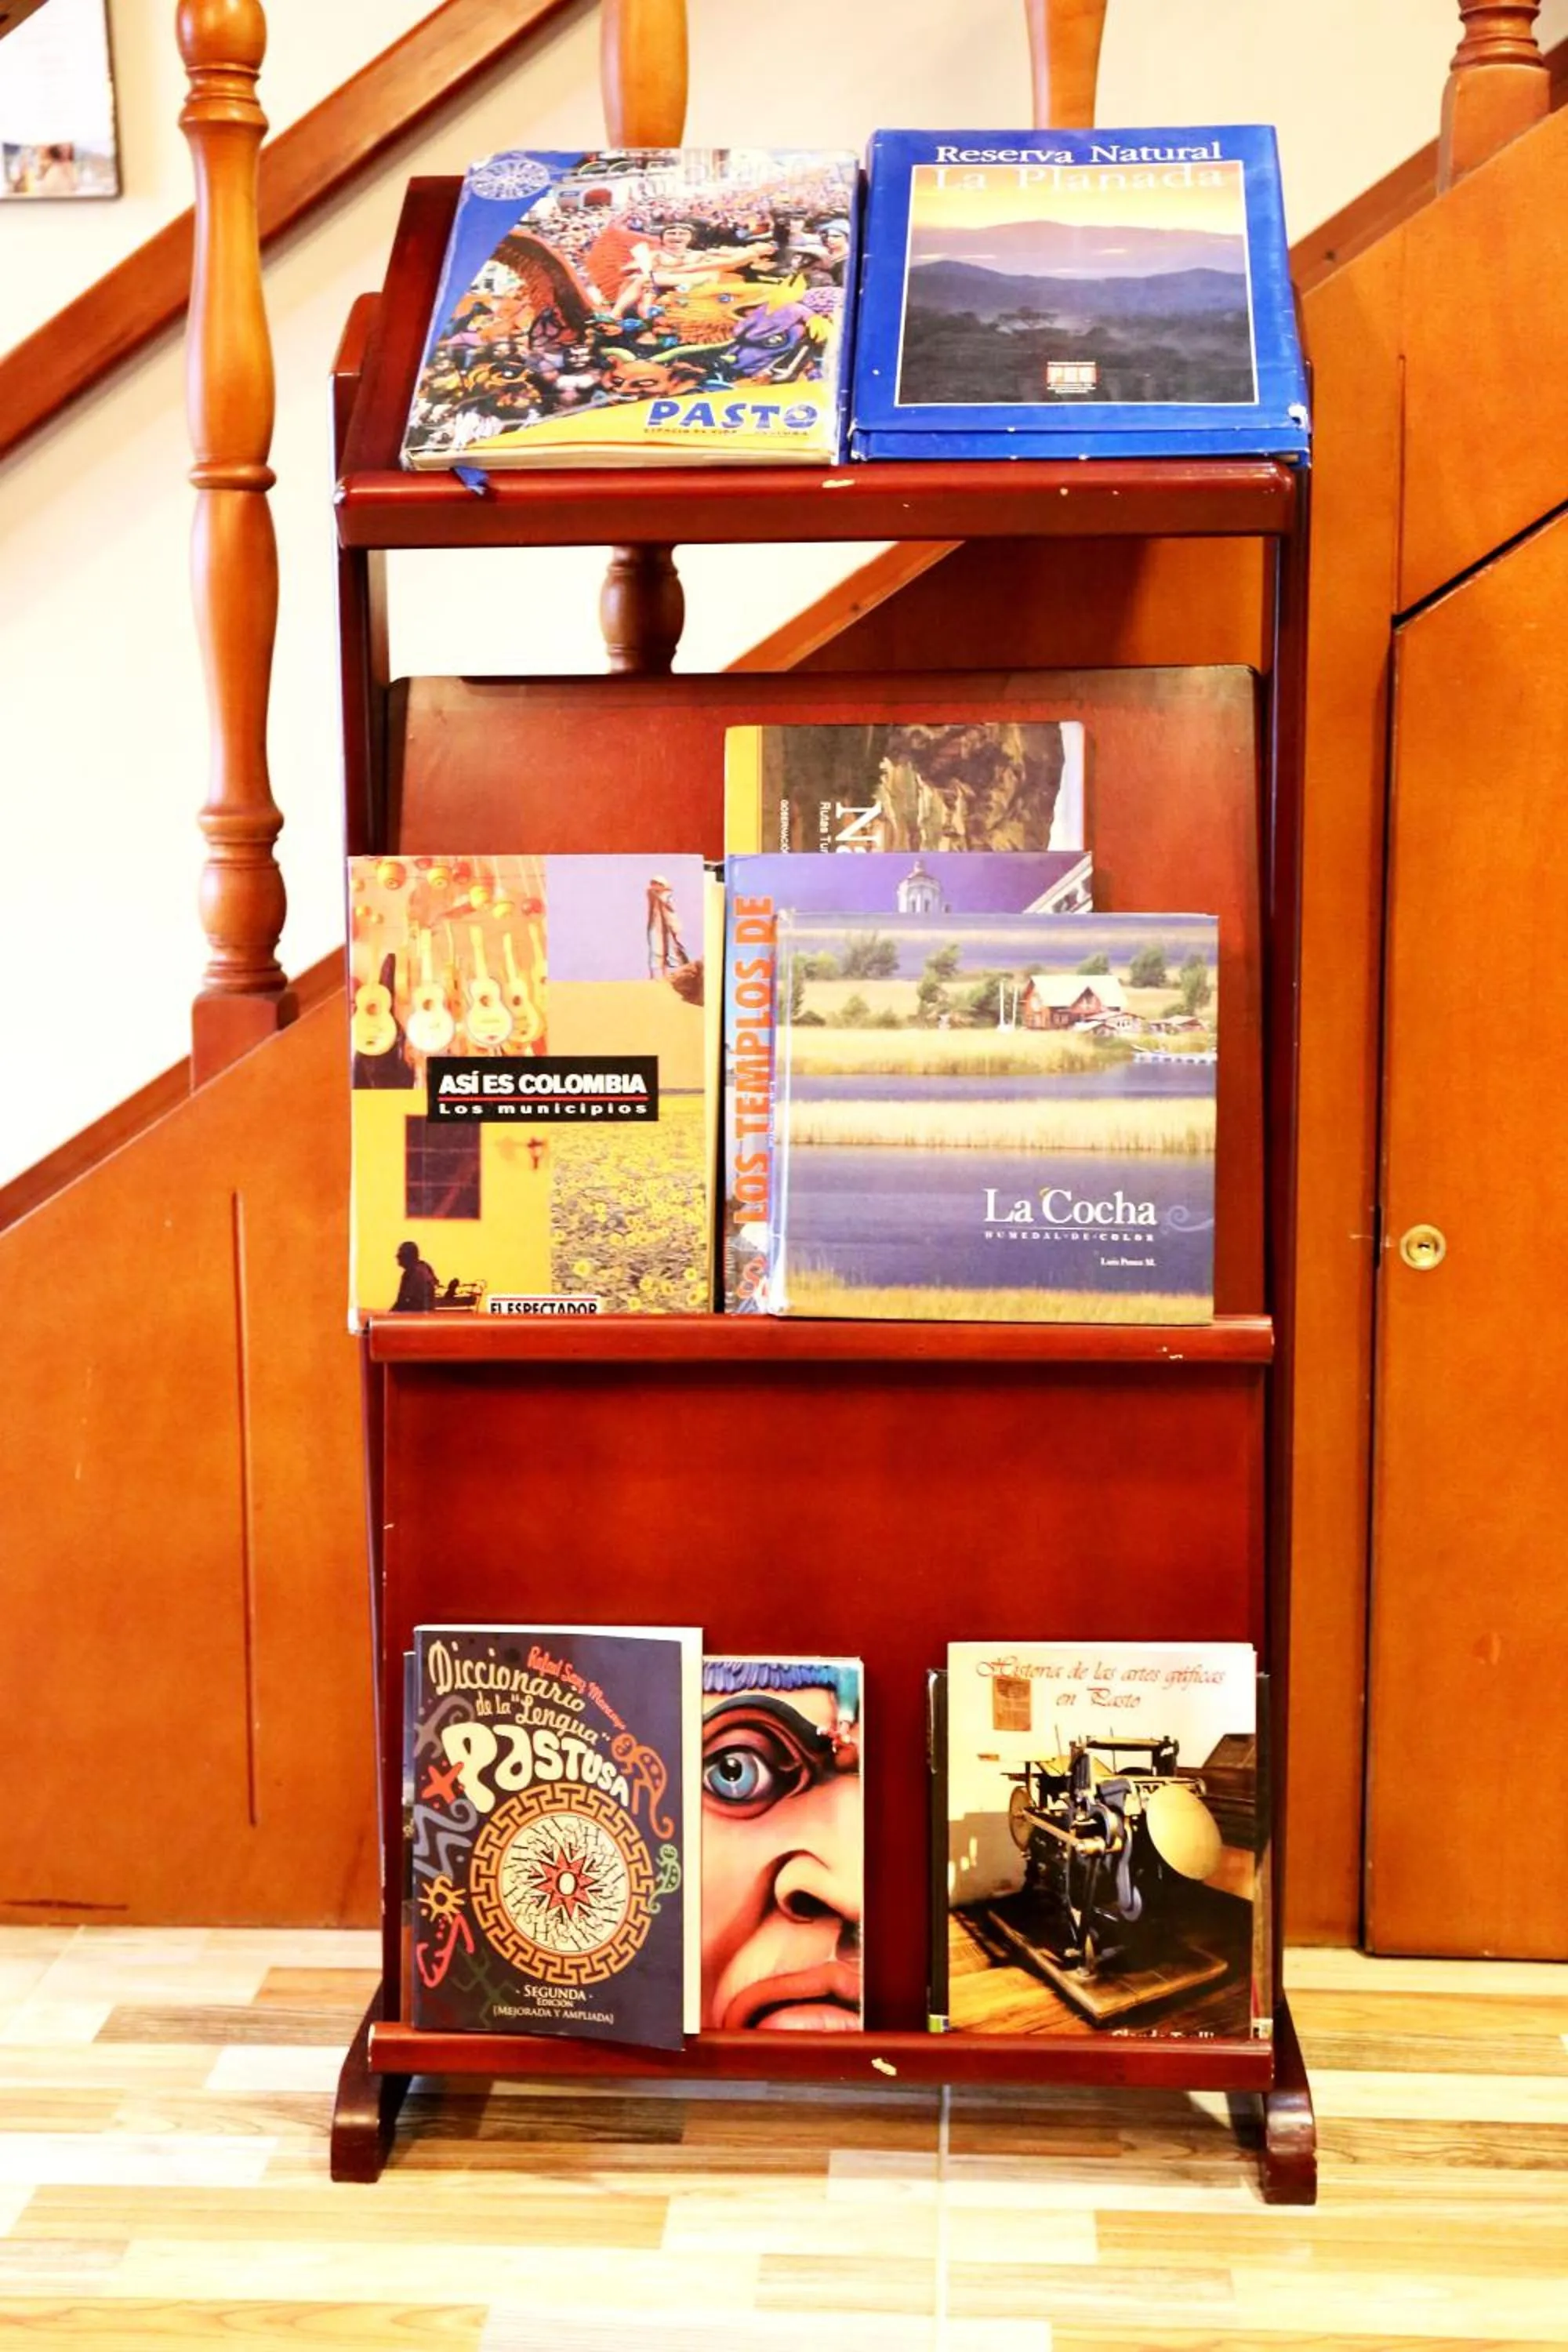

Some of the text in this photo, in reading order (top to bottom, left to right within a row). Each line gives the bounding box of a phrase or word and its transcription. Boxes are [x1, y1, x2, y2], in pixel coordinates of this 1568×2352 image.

[936, 141, 1223, 164] Reserva Natural
[935, 164, 1225, 192] La Planada
[647, 400, 818, 429] PASTO
[733, 895, 775, 946] DE
[733, 957, 771, 1140] TEMPLOS
[438, 1070, 648, 1094] ASÍ ES COLOMBIA
[439, 1103, 648, 1116] Los municipios
[733, 1152, 769, 1224] LOS
[982, 1188, 1158, 1225] La Cocha
[507, 1302, 597, 1314] ESPECTADOR
[428, 1639, 586, 1711] Diccionario
[975, 1655, 1062, 1680] Historia
[1067, 1661, 1089, 1681] de
[1094, 1661, 1117, 1682] las
[1120, 1667, 1160, 1683] artes
[475, 1690, 492, 1716] de
[495, 1693, 511, 1715] la
[1056, 1686, 1142, 1709] en Pasto
[524, 1984, 586, 2001] SEGUNDA
